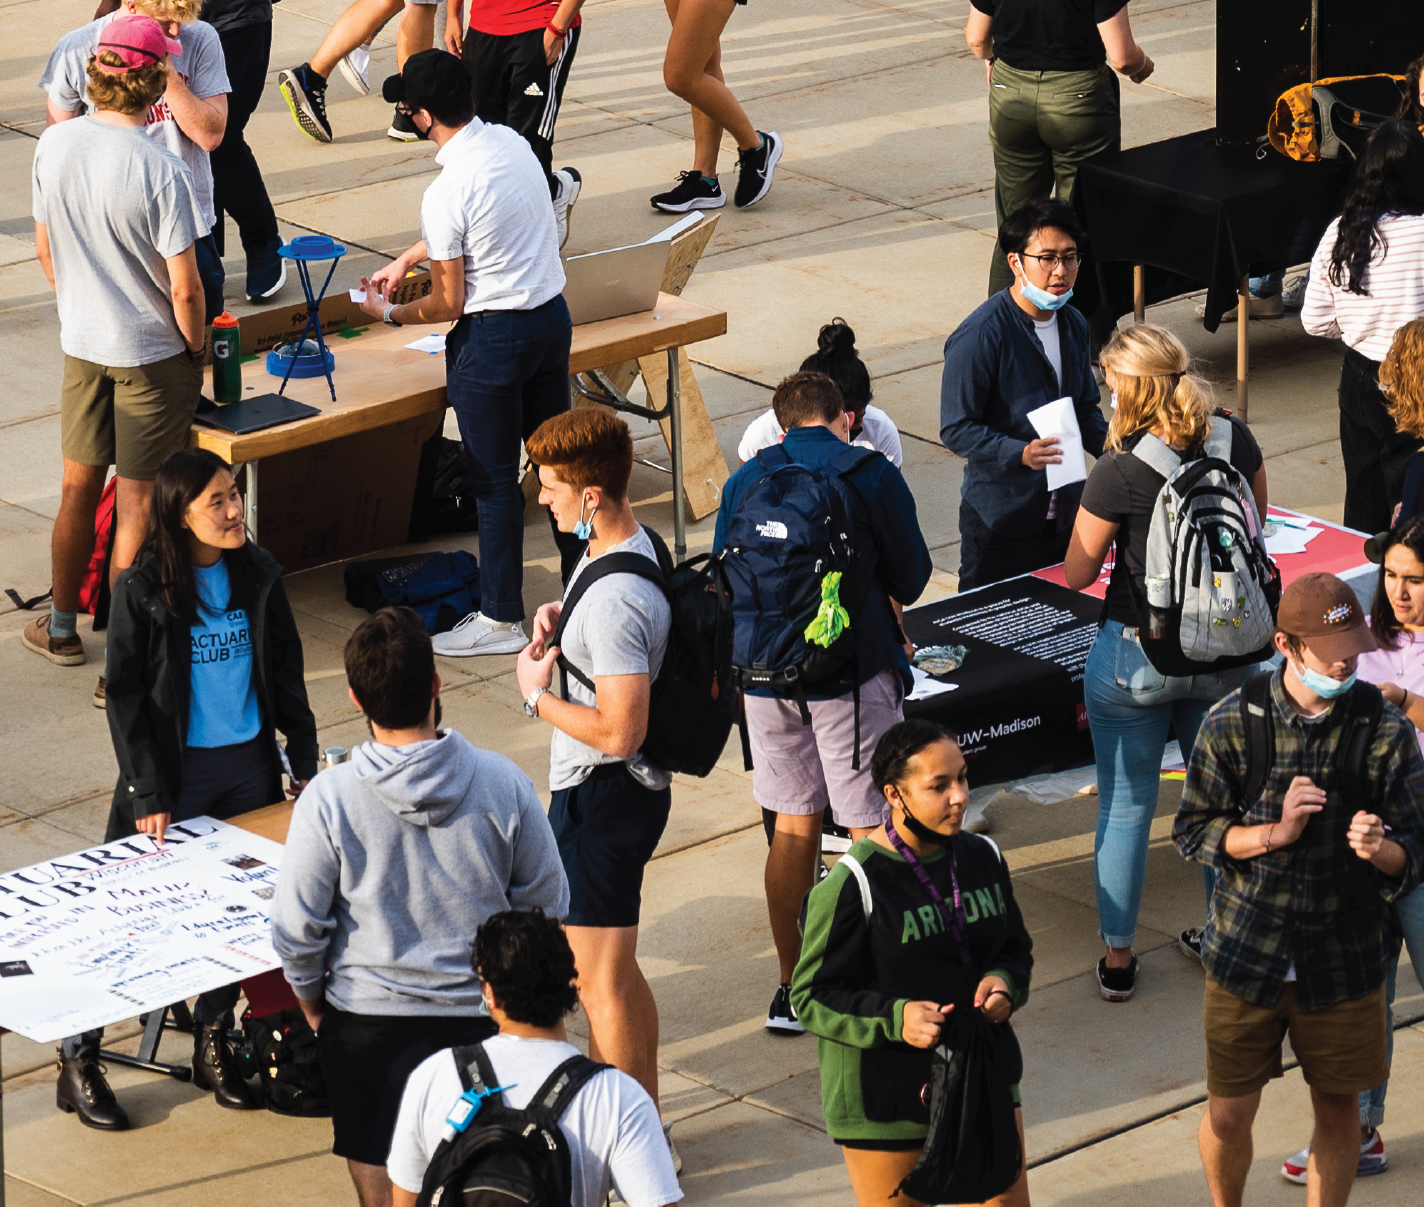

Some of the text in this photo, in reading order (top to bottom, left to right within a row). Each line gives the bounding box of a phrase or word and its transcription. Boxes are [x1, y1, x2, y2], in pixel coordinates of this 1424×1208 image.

[213, 340, 230, 359] G
[190, 648, 231, 665] CLUB
[957, 714, 1042, 748] UW-Madison
